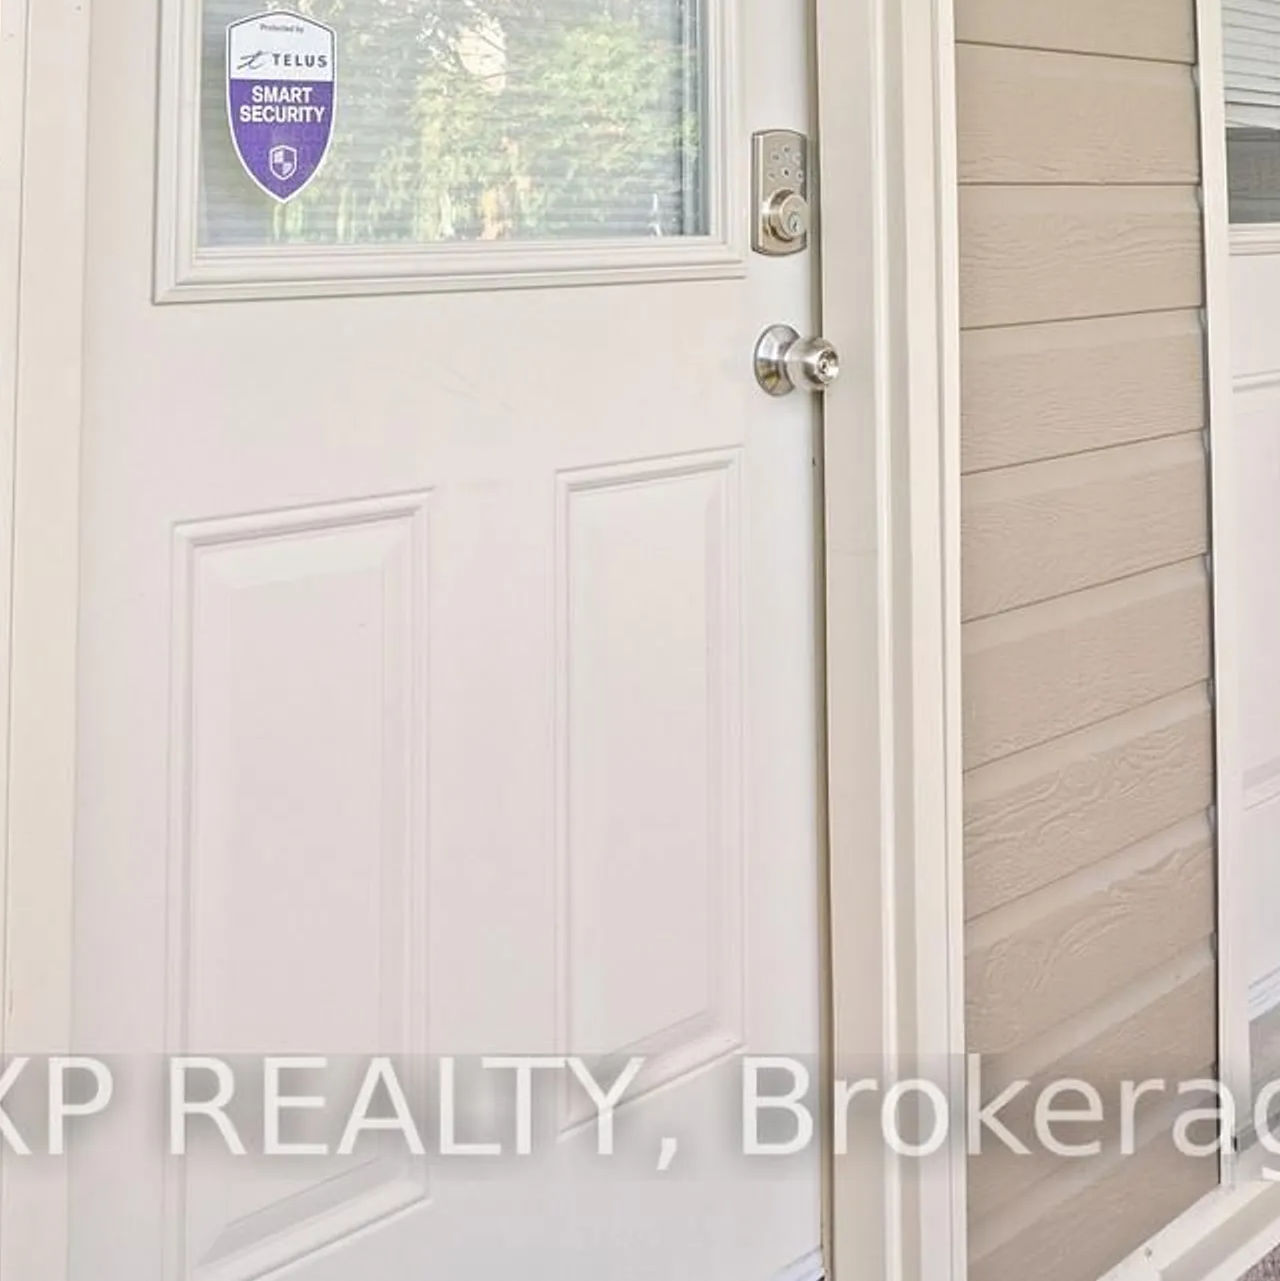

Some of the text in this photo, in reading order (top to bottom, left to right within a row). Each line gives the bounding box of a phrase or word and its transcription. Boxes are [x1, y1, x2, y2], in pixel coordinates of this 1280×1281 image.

[272, 54, 328, 68] TELUS
[251, 85, 313, 103] SMART
[239, 105, 325, 123] SECURITY
